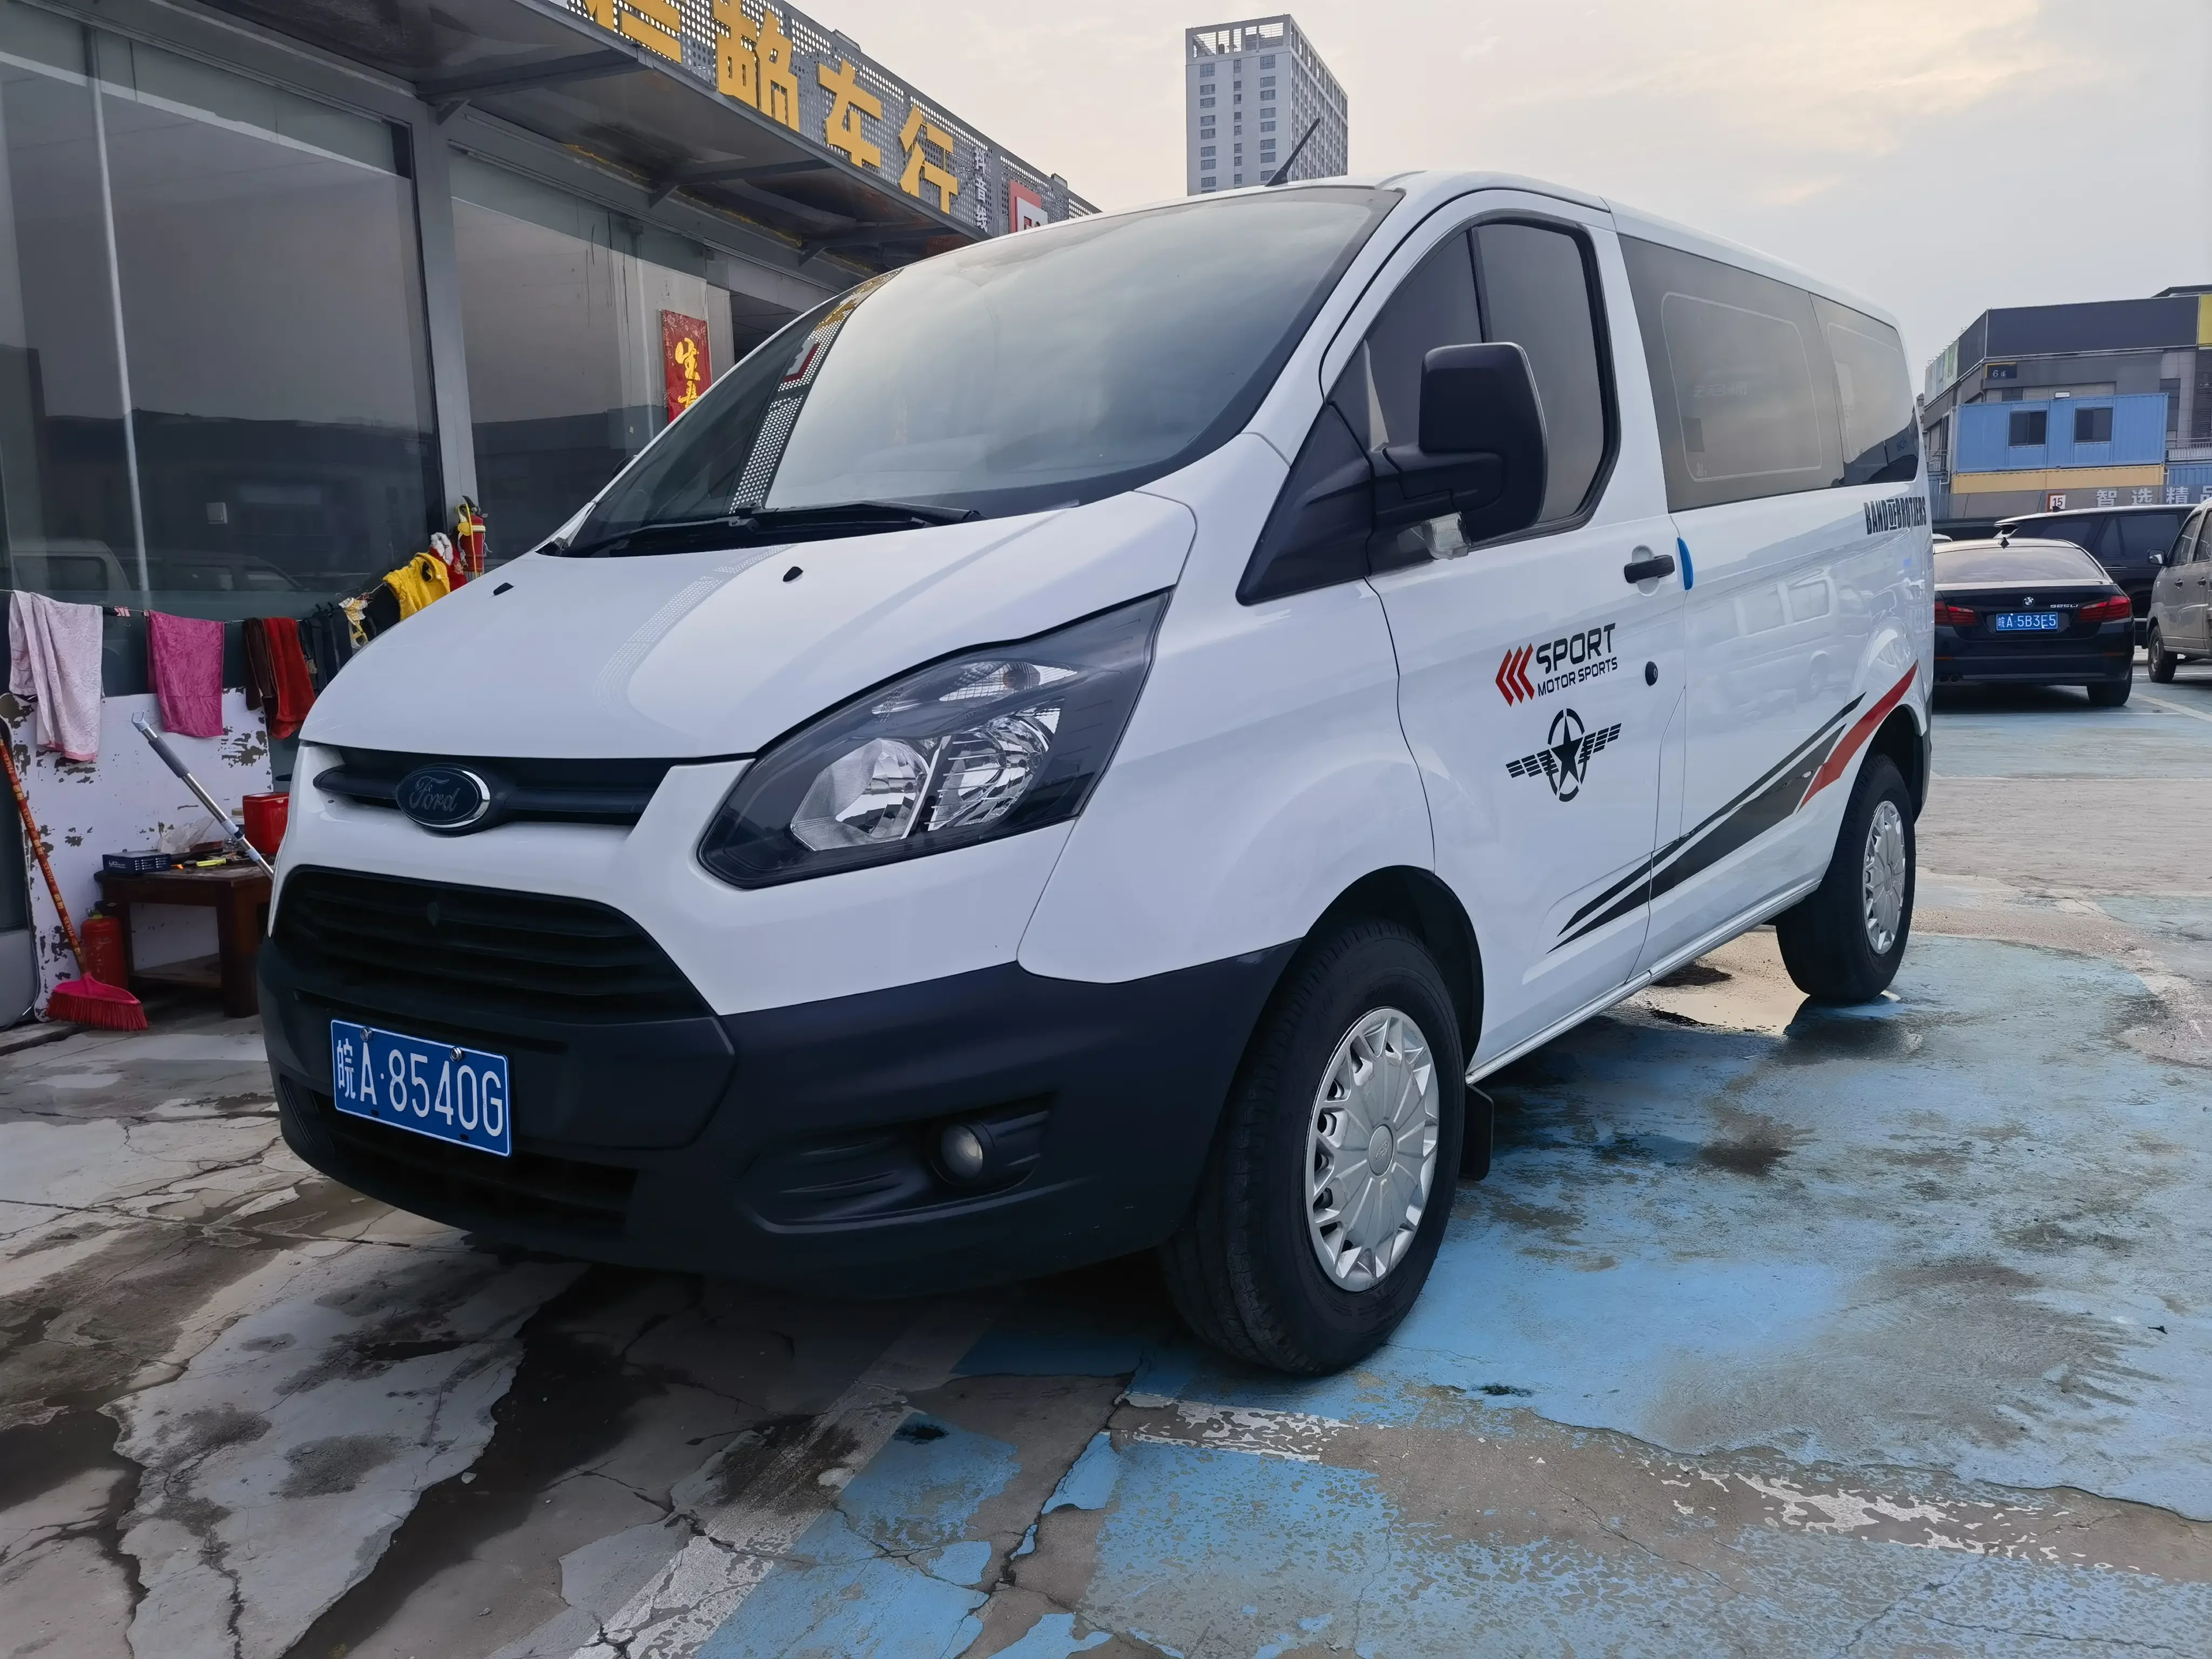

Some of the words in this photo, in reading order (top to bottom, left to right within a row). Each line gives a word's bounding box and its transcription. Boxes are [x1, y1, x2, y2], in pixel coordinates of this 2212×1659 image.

[2053, 497, 2063, 507] 15
[1536, 622, 1616, 674] SPORT
[1537, 672, 1576, 697] MOTOR
[1579, 657, 1618, 683] SPORTS
[409, 776, 460, 812] Ford
